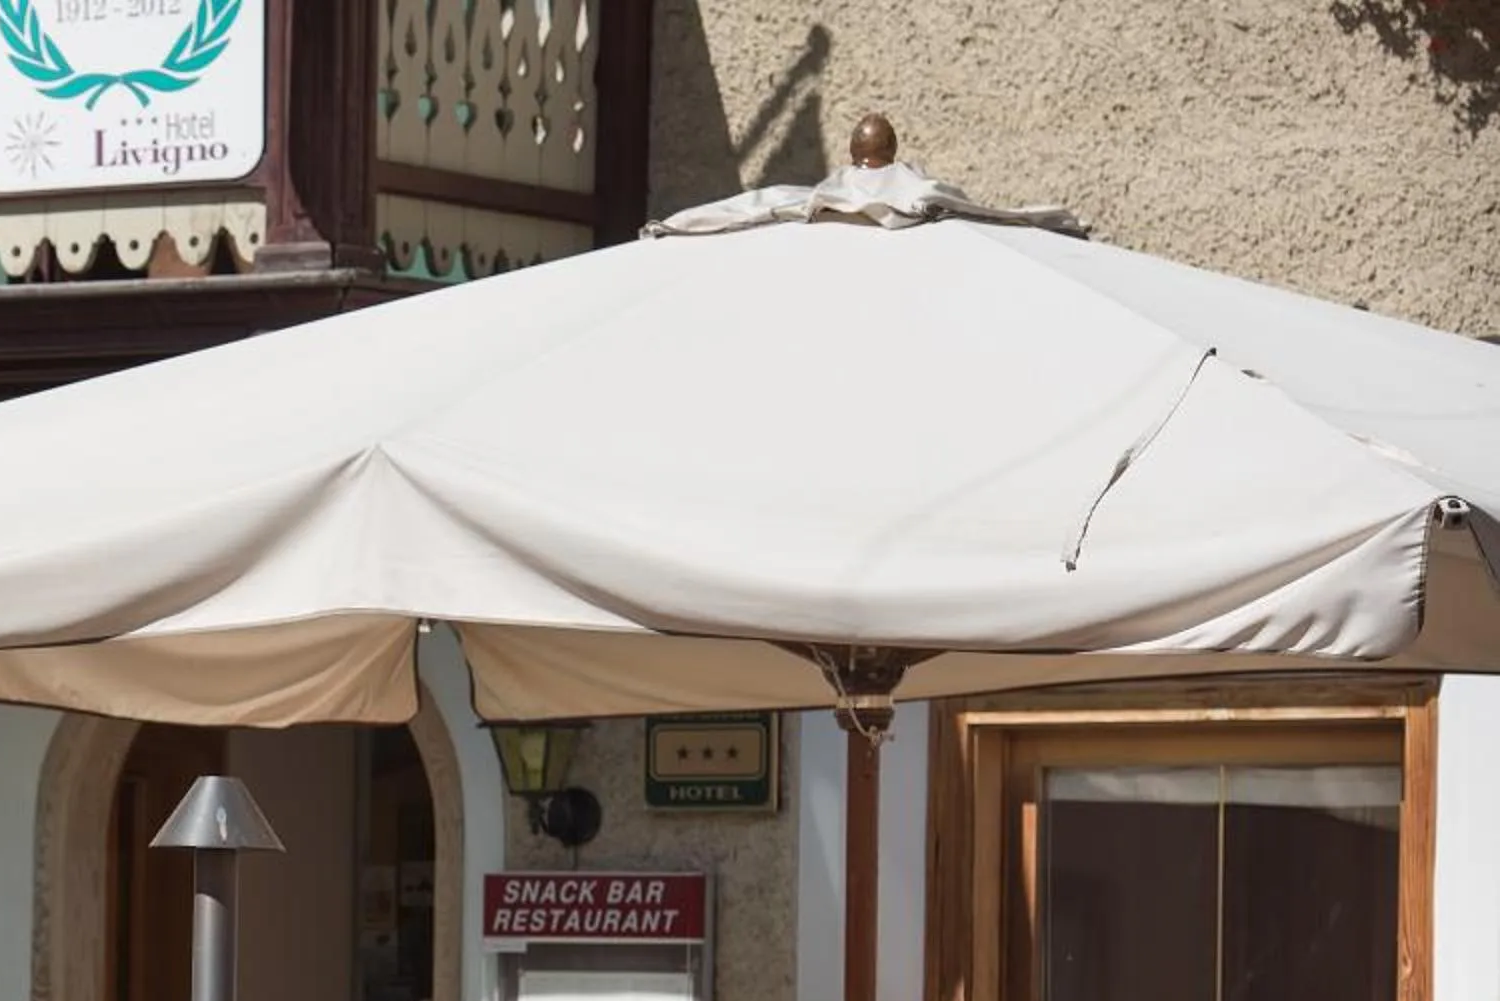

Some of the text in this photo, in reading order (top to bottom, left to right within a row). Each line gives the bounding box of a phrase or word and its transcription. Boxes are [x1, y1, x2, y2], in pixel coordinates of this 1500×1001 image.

[165, 110, 215, 141] Hotel
[91, 128, 228, 175] Livigno
[669, 785, 743, 801] HOTEL
[503, 880, 665, 904] SNACK BAR
[493, 908, 678, 932] RESTAURANT
